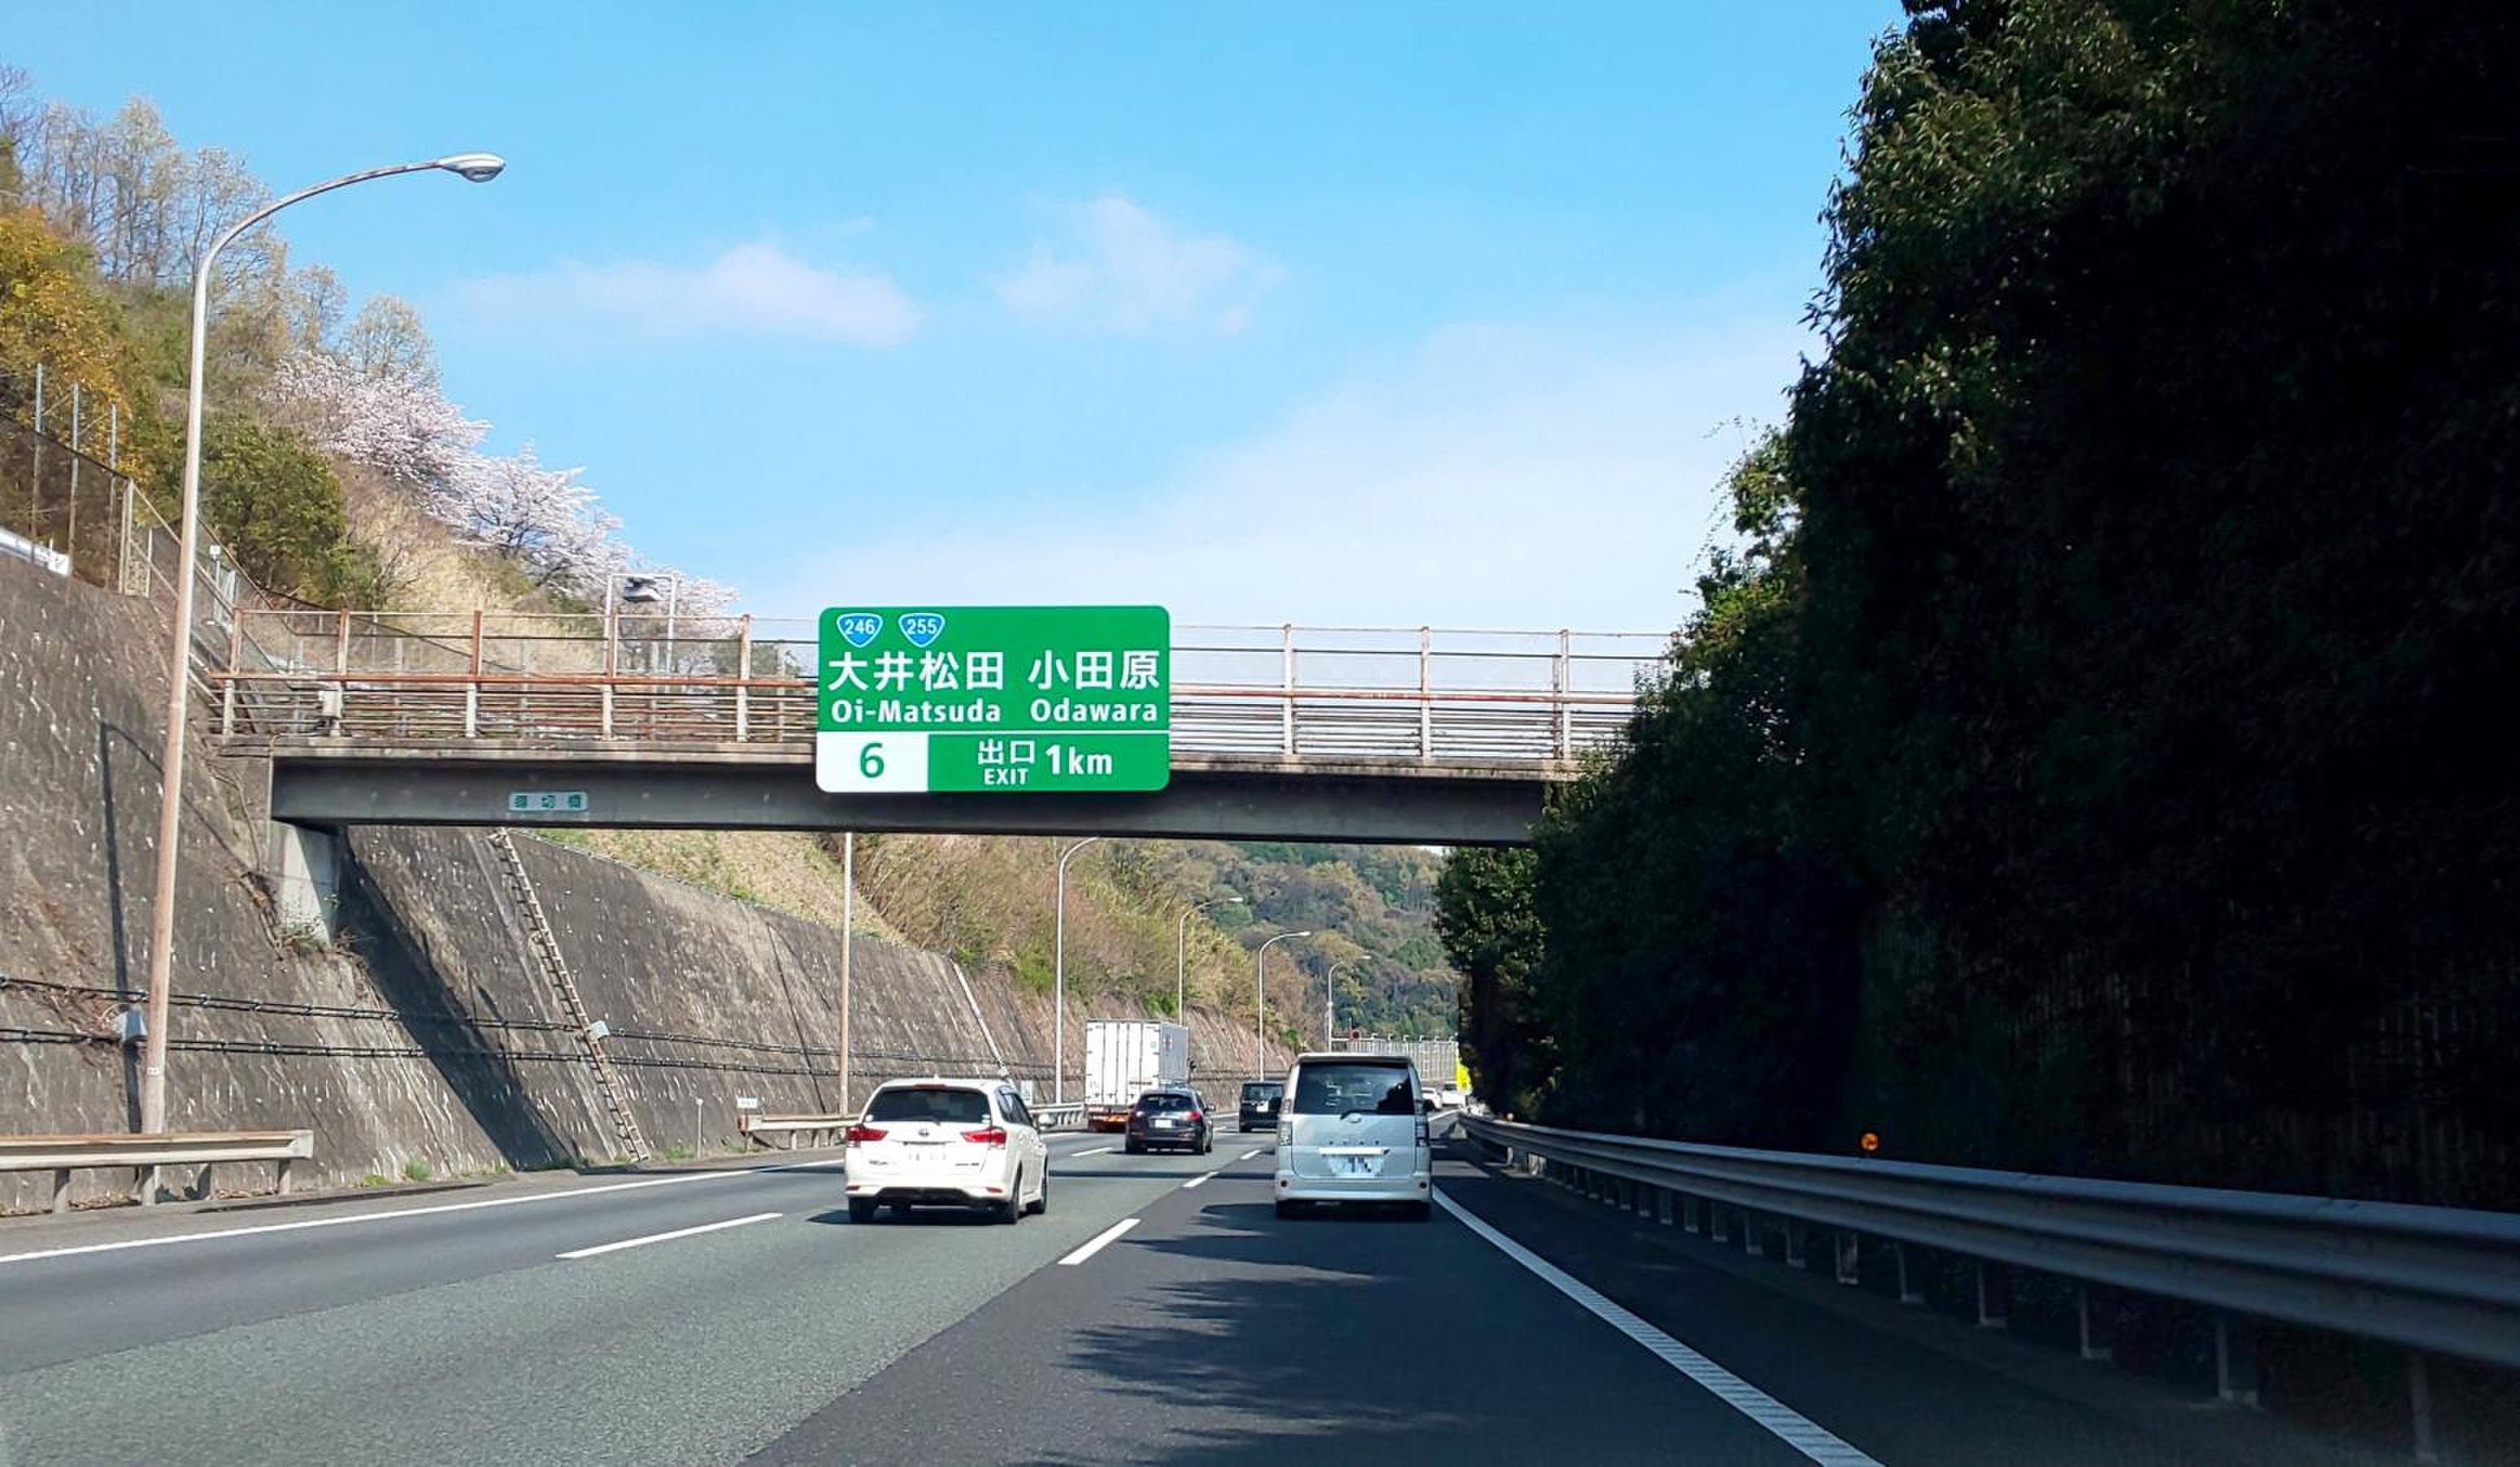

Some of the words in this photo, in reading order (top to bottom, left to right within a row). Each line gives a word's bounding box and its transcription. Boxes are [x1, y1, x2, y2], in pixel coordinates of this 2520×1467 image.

[844, 619, 875, 635] 246
[906, 618, 937, 635] 255
[828, 651, 1003, 690] 大井松田
[1028, 650, 1160, 689] 小田原
[831, 698, 1001, 723] Oi-Matsuda
[1030, 698, 1157, 722] Odawara
[860, 742, 885, 778] 6
[977, 739, 1035, 764] 出口
[984, 769, 1029, 785] EXIT
